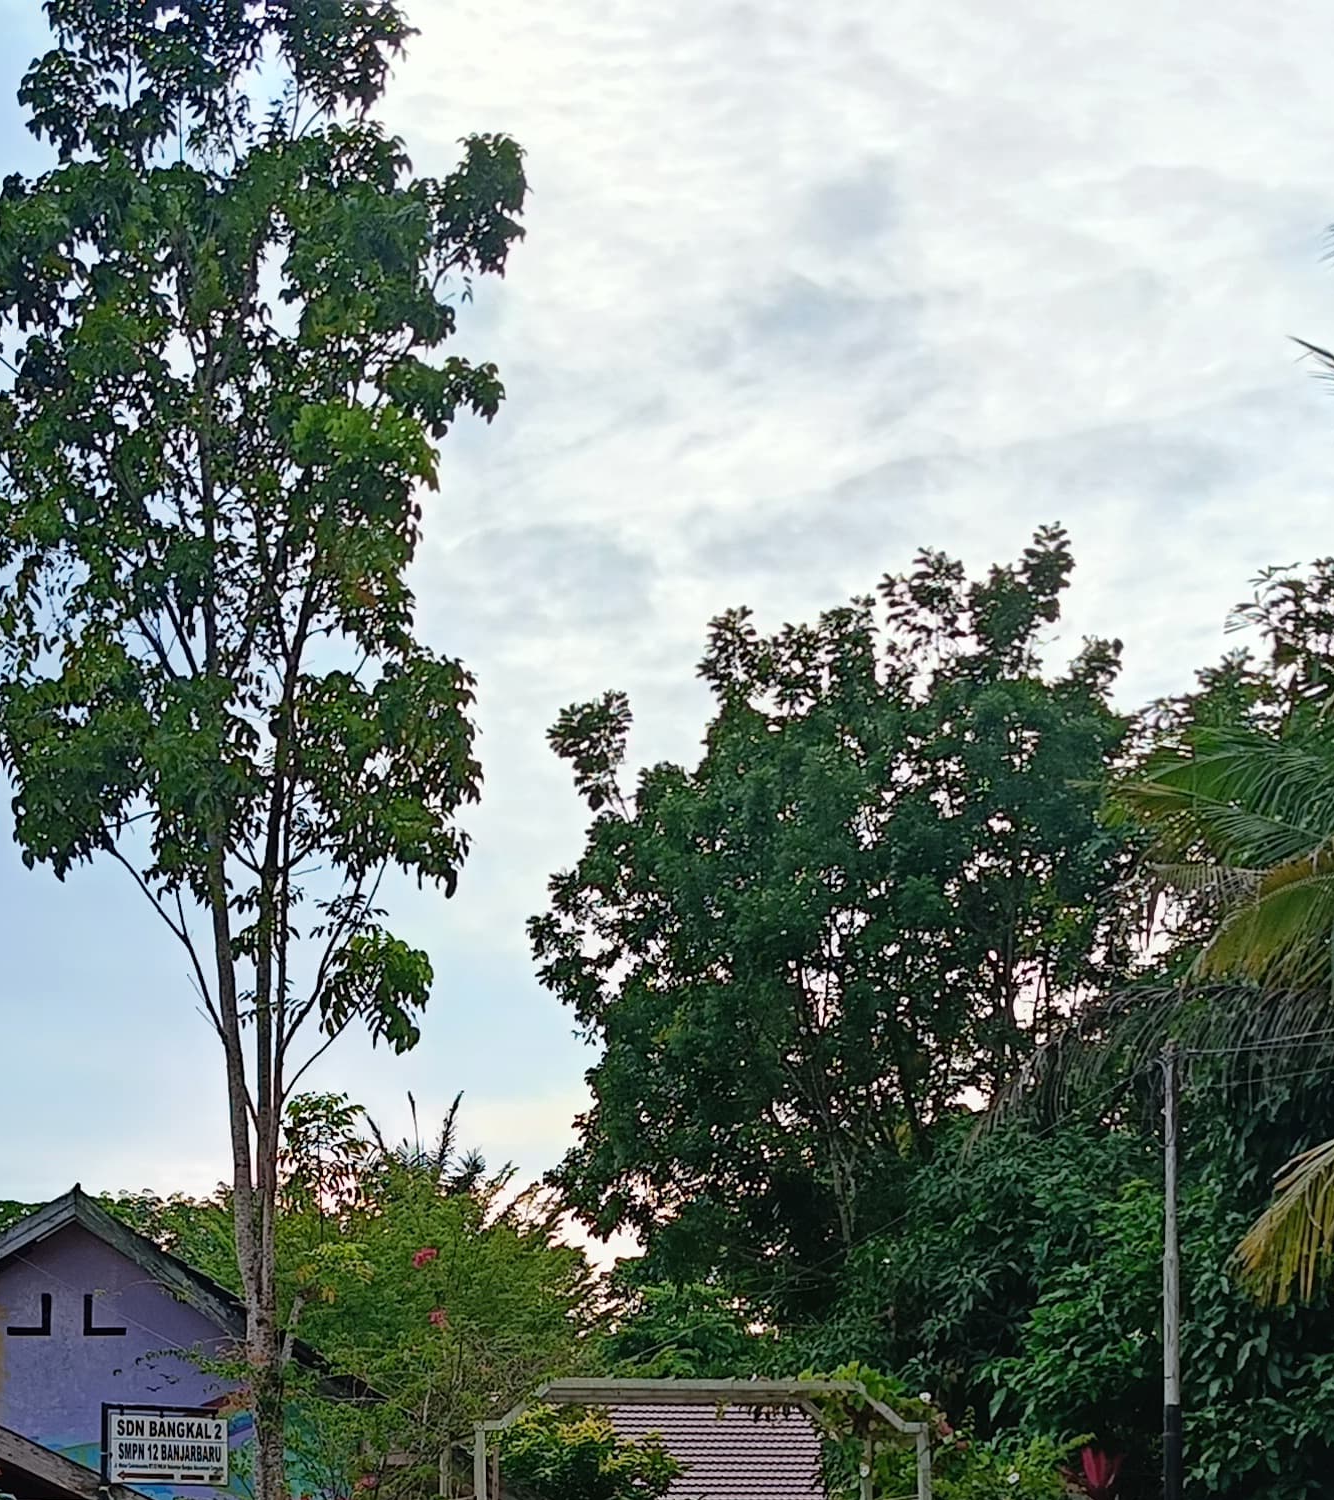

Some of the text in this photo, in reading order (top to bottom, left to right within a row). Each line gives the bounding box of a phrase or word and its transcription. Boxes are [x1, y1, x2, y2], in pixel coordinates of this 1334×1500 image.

[117, 1419, 222, 1440] SDN BANGKAL 2
[118, 1442, 221, 1463] SMPN 12 BANJARBARU
